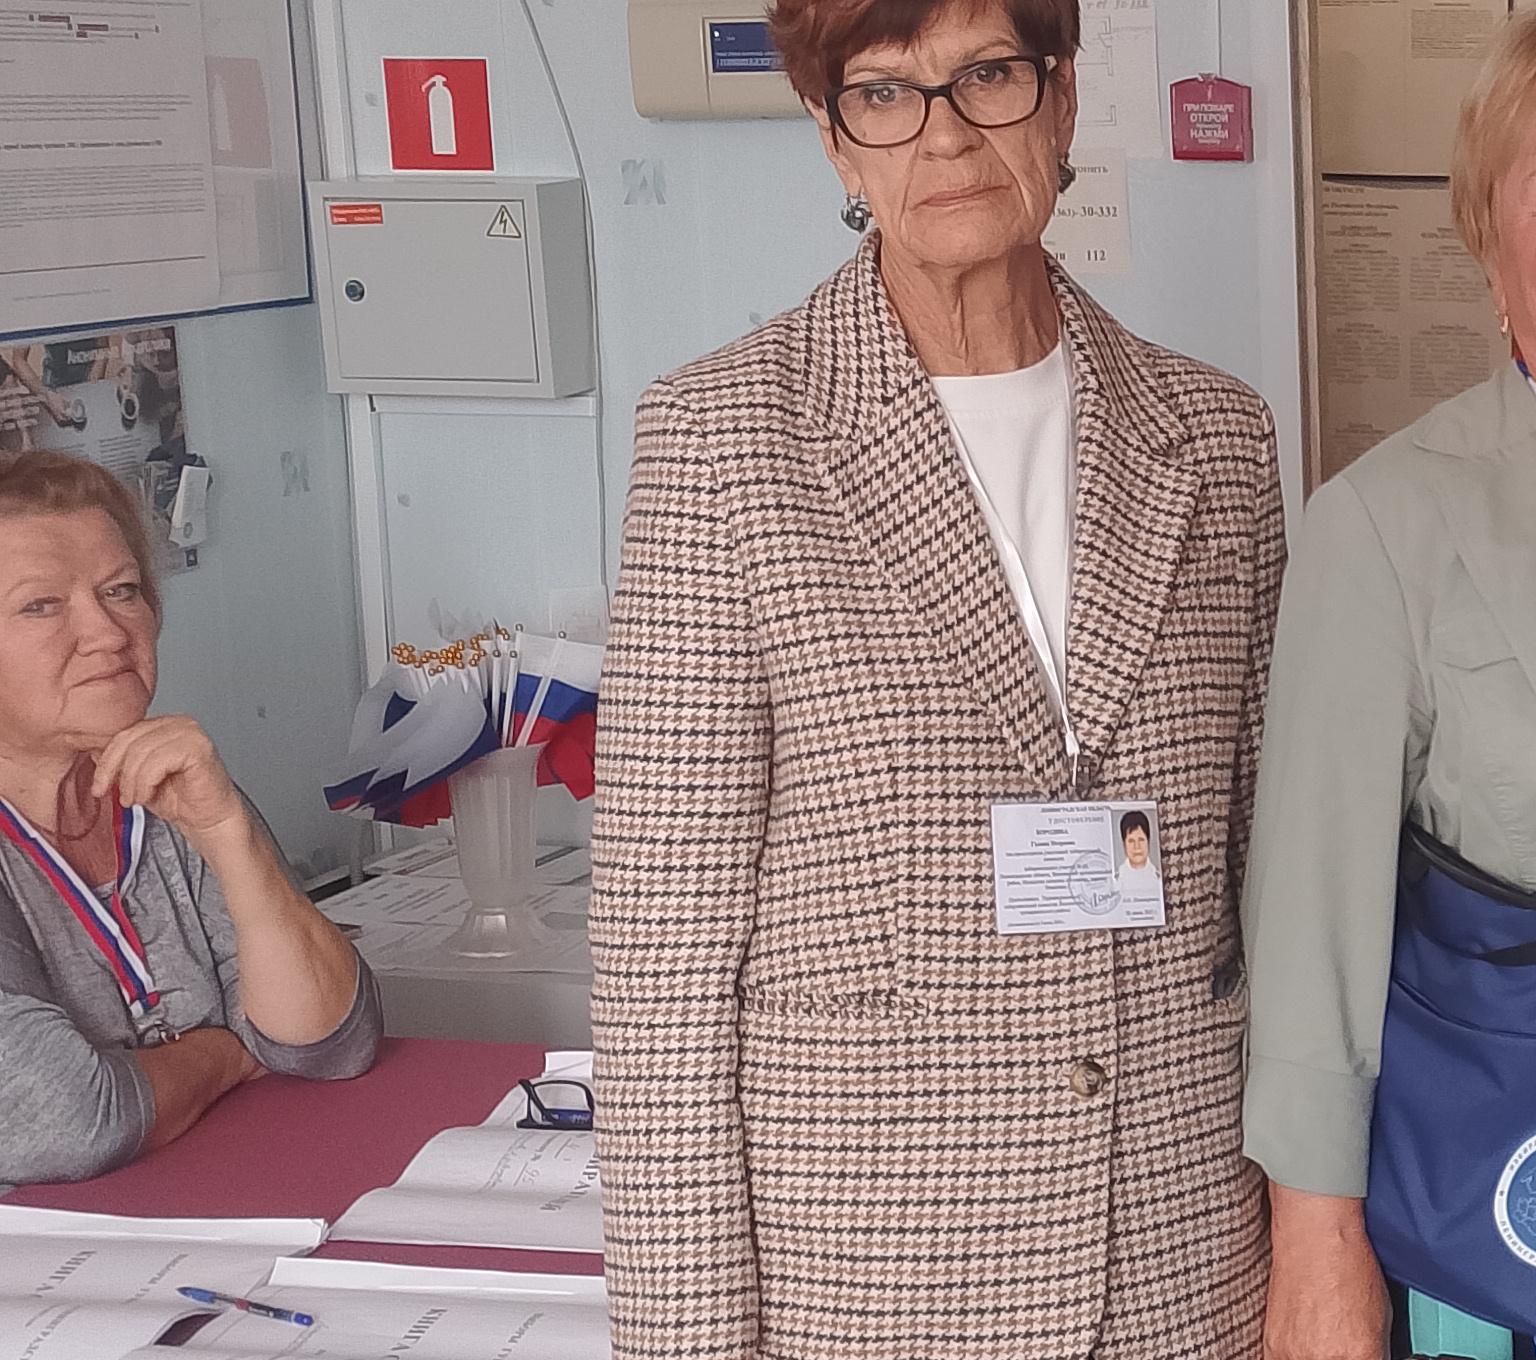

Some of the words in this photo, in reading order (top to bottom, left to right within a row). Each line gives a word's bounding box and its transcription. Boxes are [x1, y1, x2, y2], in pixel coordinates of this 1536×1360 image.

[1189, 113, 1229, 123] ОТКРОЙ
[1189, 129, 1229, 139] НАЖМИ
[1080, 206, 1118, 218] 30-332
[1086, 250, 1106, 261] 112
[390, 1307, 448, 1351] КНИГА
